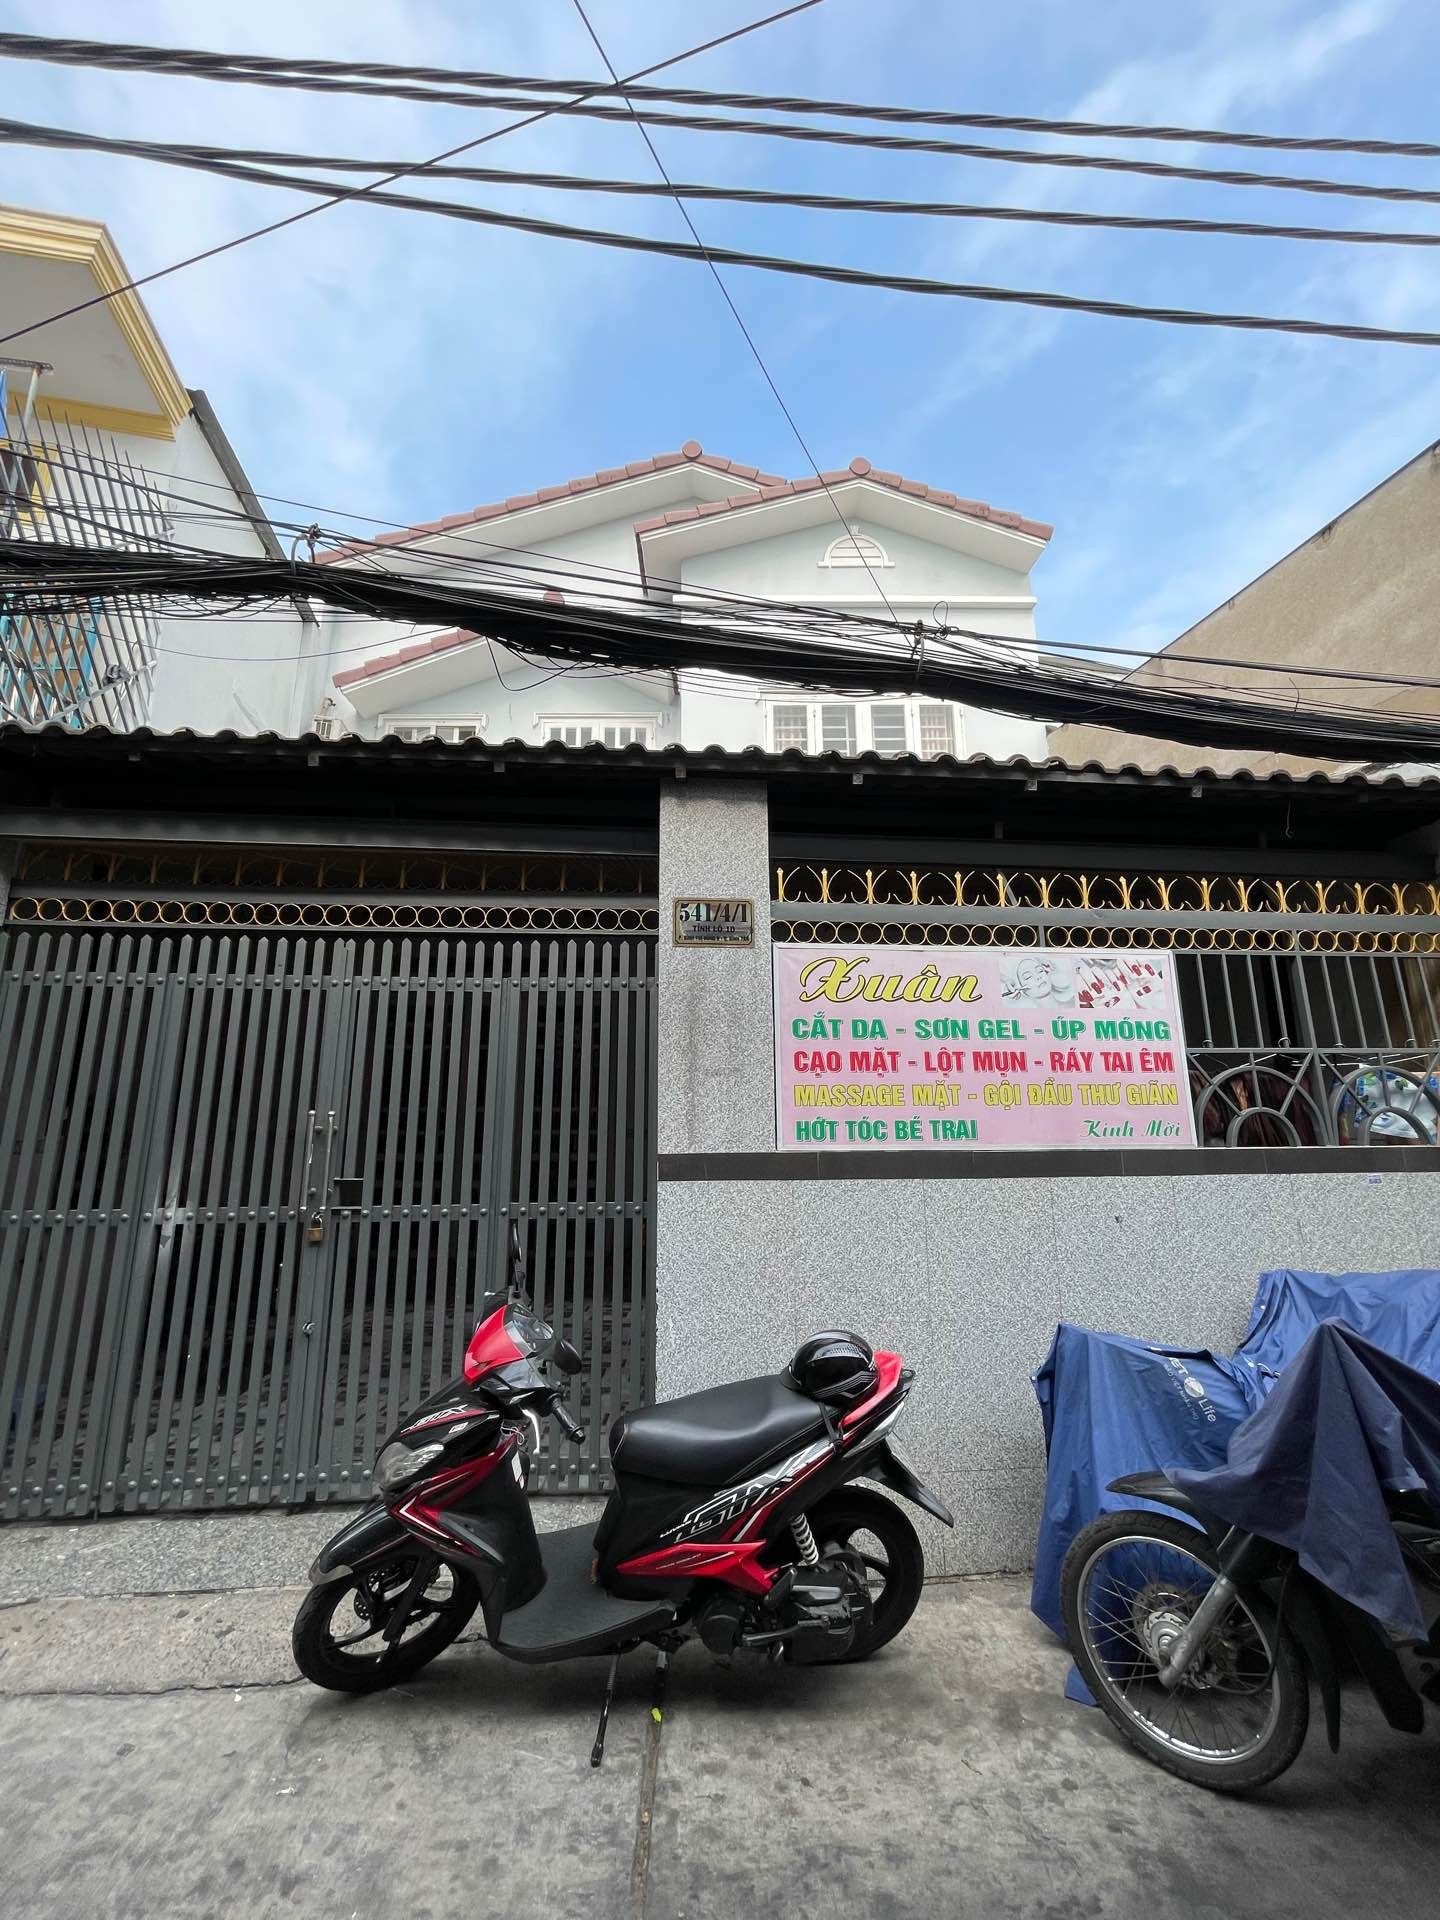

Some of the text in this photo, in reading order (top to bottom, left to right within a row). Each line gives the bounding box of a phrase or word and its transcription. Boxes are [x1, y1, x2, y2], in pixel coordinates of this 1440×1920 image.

[680, 902, 747, 922] 541/4/1
[799, 956, 983, 1003] Xuân
[792, 1011, 843, 1040] CẮT
[851, 1018, 888, 1040] DA
[914, 1017, 973, 1040] SƠN
[978, 1019, 1027, 1041] GEL
[1051, 1016, 1086, 1041] ÚP
[1094, 1017, 1172, 1041] MÓNG
[793, 1051, 842, 1078] CẠO
[850, 1047, 901, 1078] MẶT
[925, 1047, 964, 1078] LỘT
[972, 1051, 1028, 1077] MỤN
[1050, 1048, 1094, 1073] RÁY
[1100, 1051, 1134, 1073] TAI
[1140, 1048, 1176, 1073] ÊM
[793, 1084, 905, 1107] MASSAGE
[912, 1080, 961, 1111] MẶT
[983, 1080, 1022, 1110] GỘI
[1027, 1077, 1073, 1106] ĐẦU
[1077, 1082, 1121, 1106] THƯ
[1125, 1080, 1179, 1106] GIÃN
[796, 1116, 978, 1142] HỚT TÓC BÉ TRAI
[1142, 1119, 1182, 1138] Mời
[1198, 1398, 1217, 1422] Life
